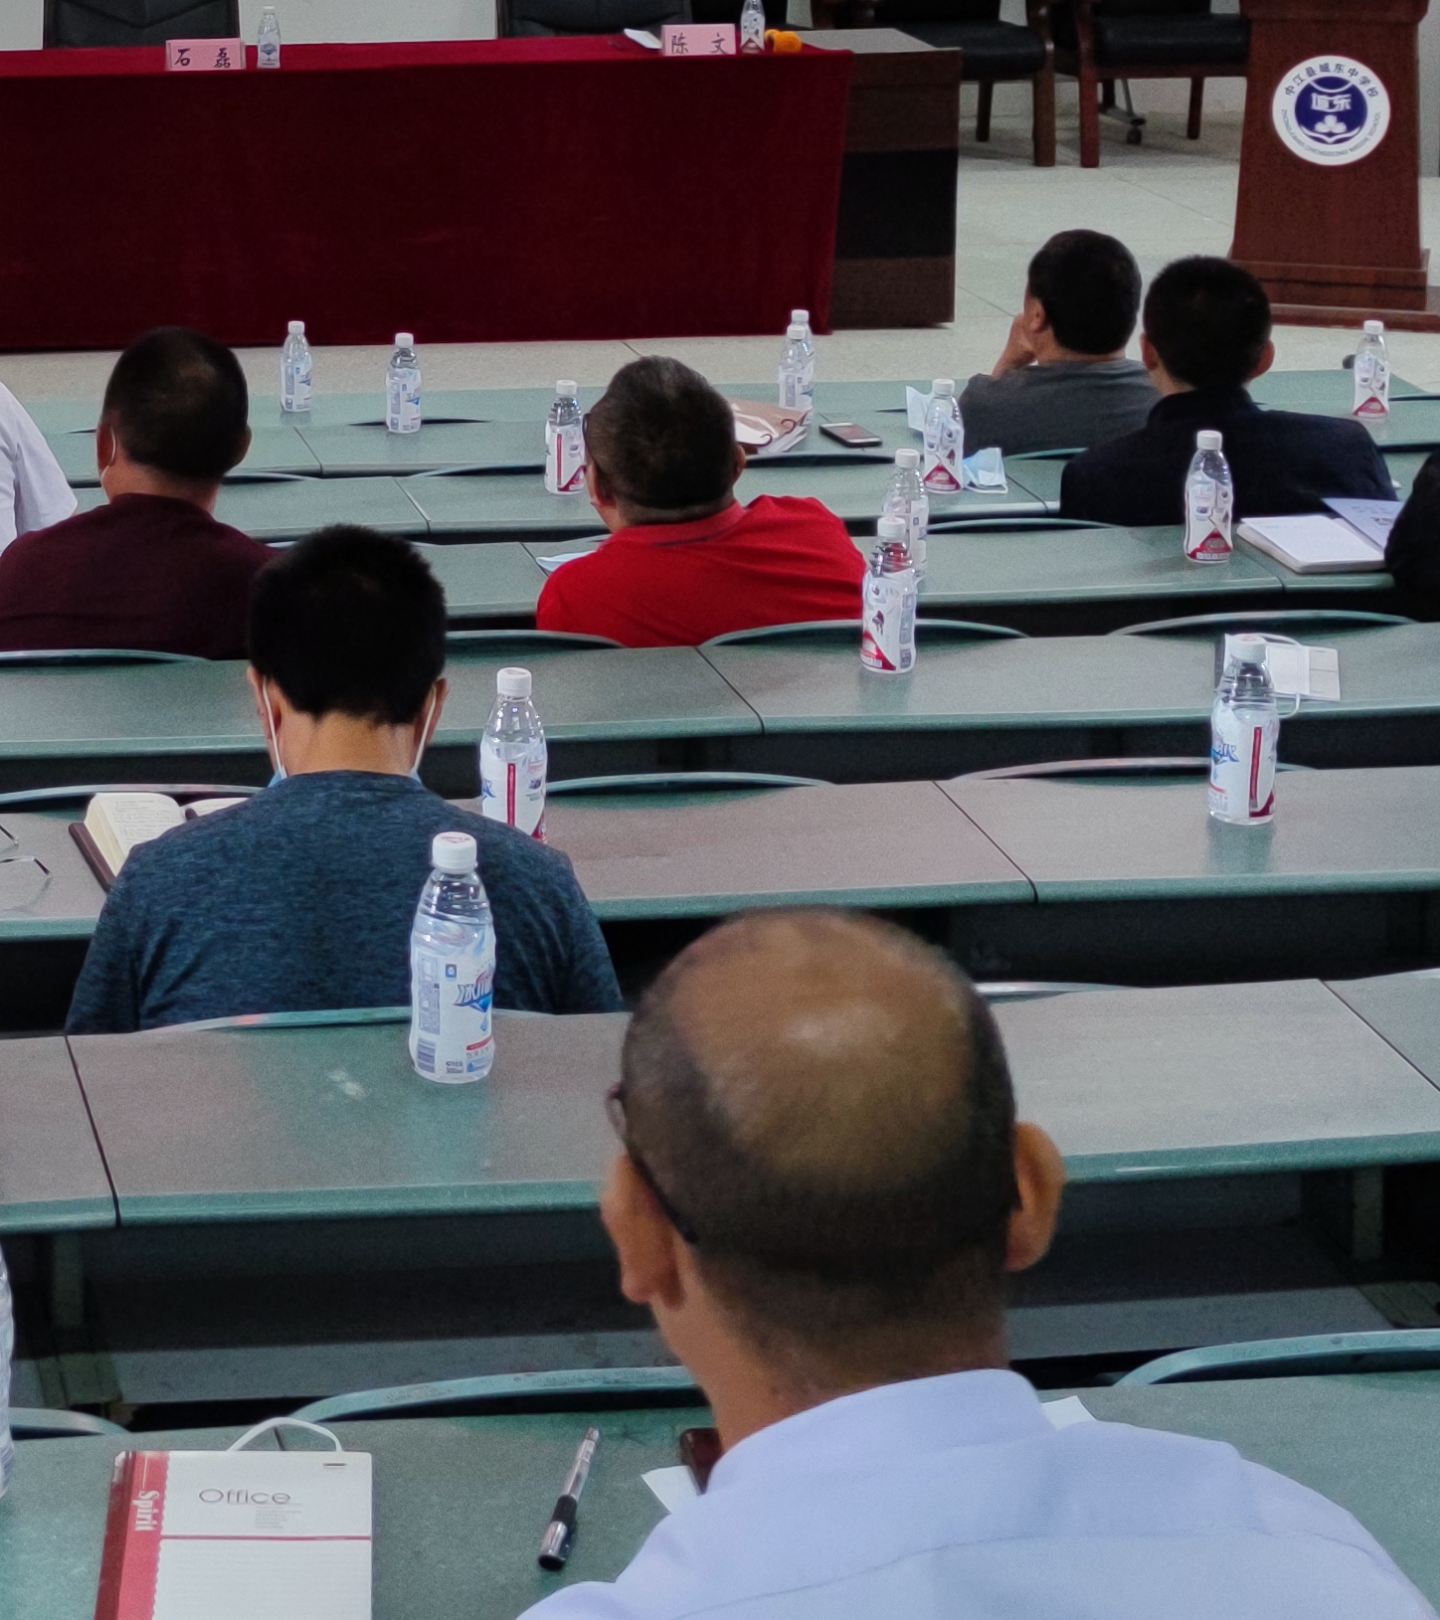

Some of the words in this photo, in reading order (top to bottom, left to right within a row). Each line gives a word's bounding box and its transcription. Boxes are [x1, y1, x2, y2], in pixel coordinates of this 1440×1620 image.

[173, 49, 232, 70] 石磊
[198, 1488, 292, 1505] Office
[131, 1489, 160, 1532] Spirit
